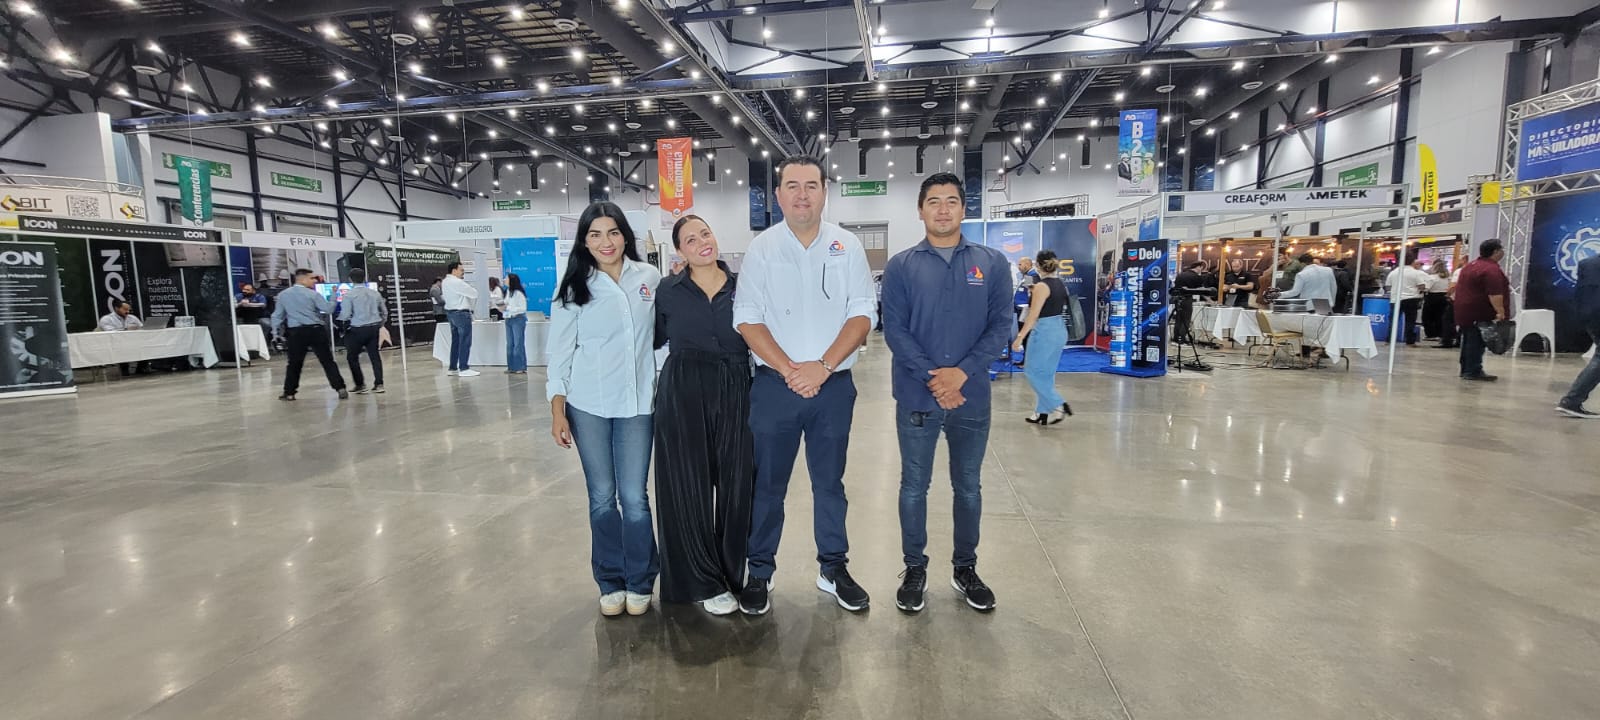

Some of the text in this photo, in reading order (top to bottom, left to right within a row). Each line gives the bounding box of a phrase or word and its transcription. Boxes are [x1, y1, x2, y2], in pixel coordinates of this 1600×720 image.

[674, 152, 684, 198] Economía
[191, 169, 204, 219] Conferencias
[1225, 190, 1368, 204] CREAFORM AMETEK
[24, 219, 58, 231] ICON
[184, 231, 207, 240] ICON
[290, 237, 317, 246] FRAX
[1139, 247, 1162, 260] Delo
[147, 278, 172, 287] Explora
[148, 285, 177, 293] nuestros
